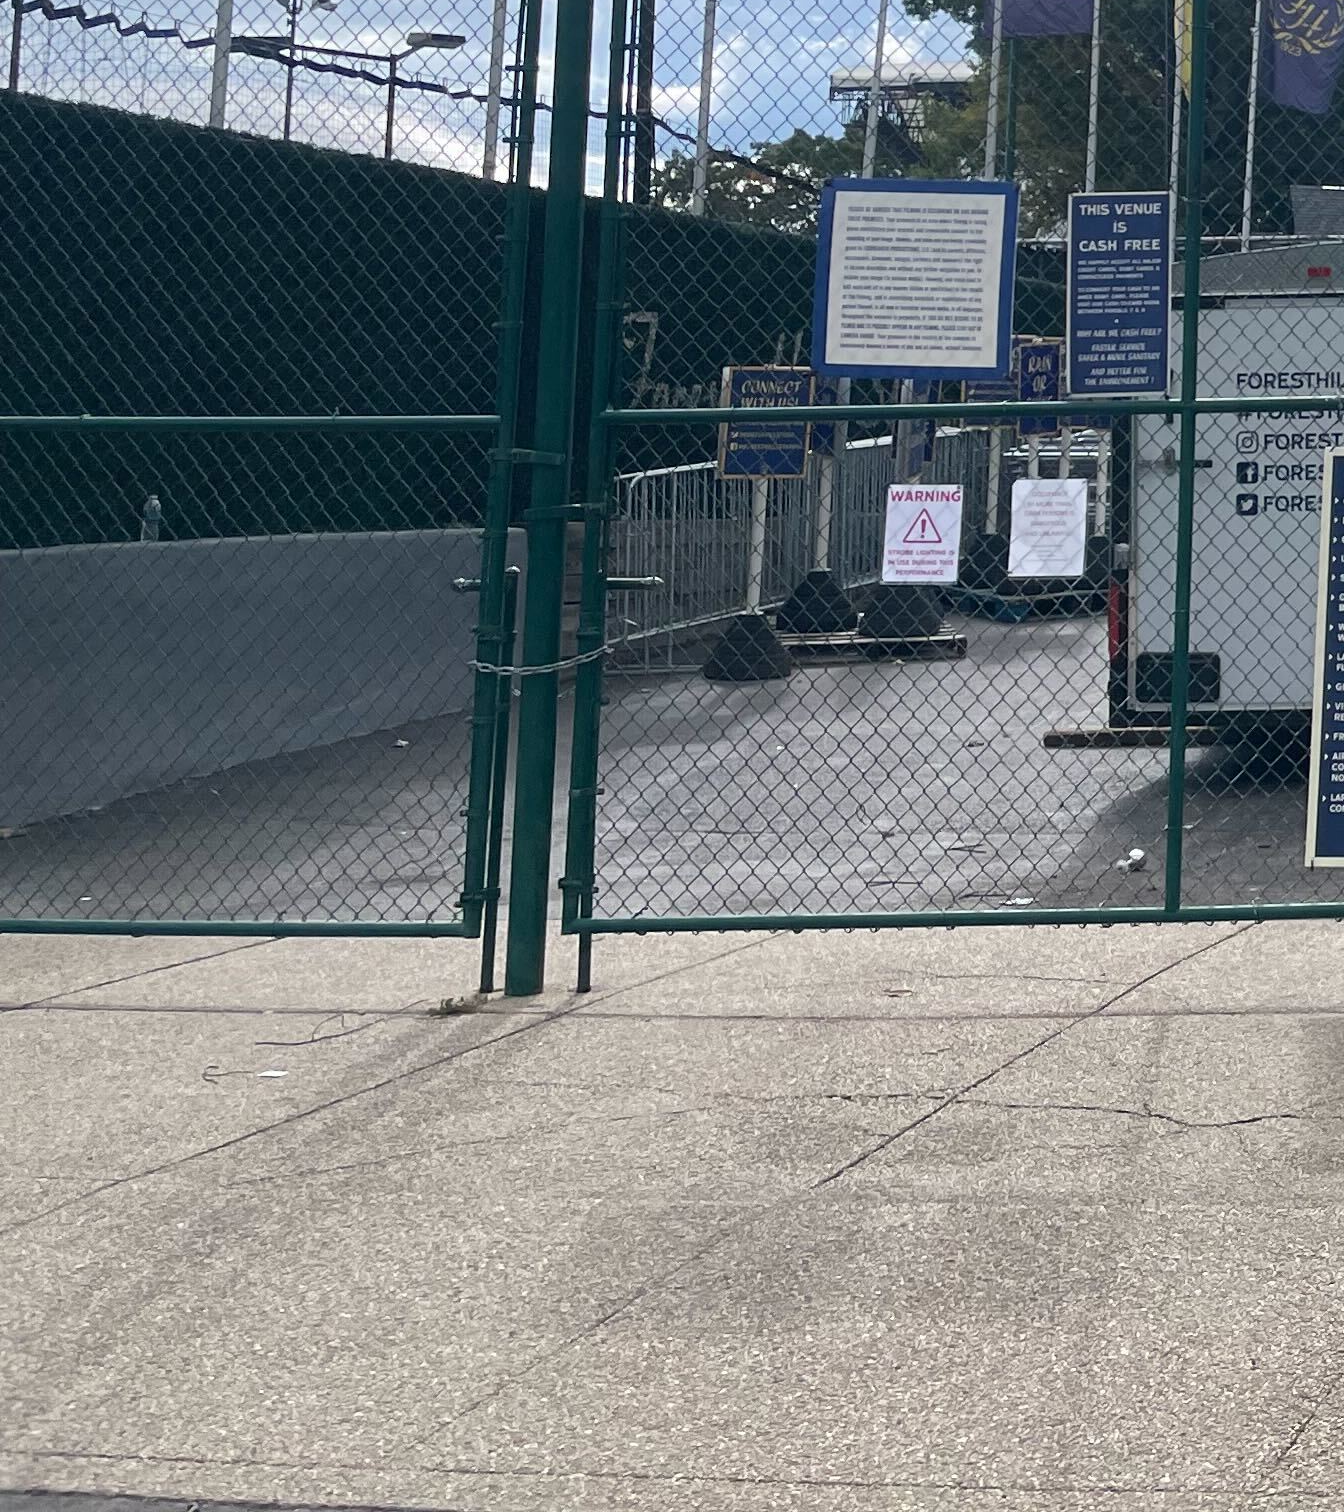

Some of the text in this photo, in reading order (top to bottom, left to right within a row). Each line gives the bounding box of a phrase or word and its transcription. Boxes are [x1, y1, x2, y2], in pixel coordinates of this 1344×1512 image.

[1079, 203, 1162, 216] THIS VENUE
[1113, 221, 1128, 233] IS
[1079, 238, 1161, 252] CASH FREE
[741, 380, 802, 394] CONNECT
[891, 490, 960, 502] WARNING
